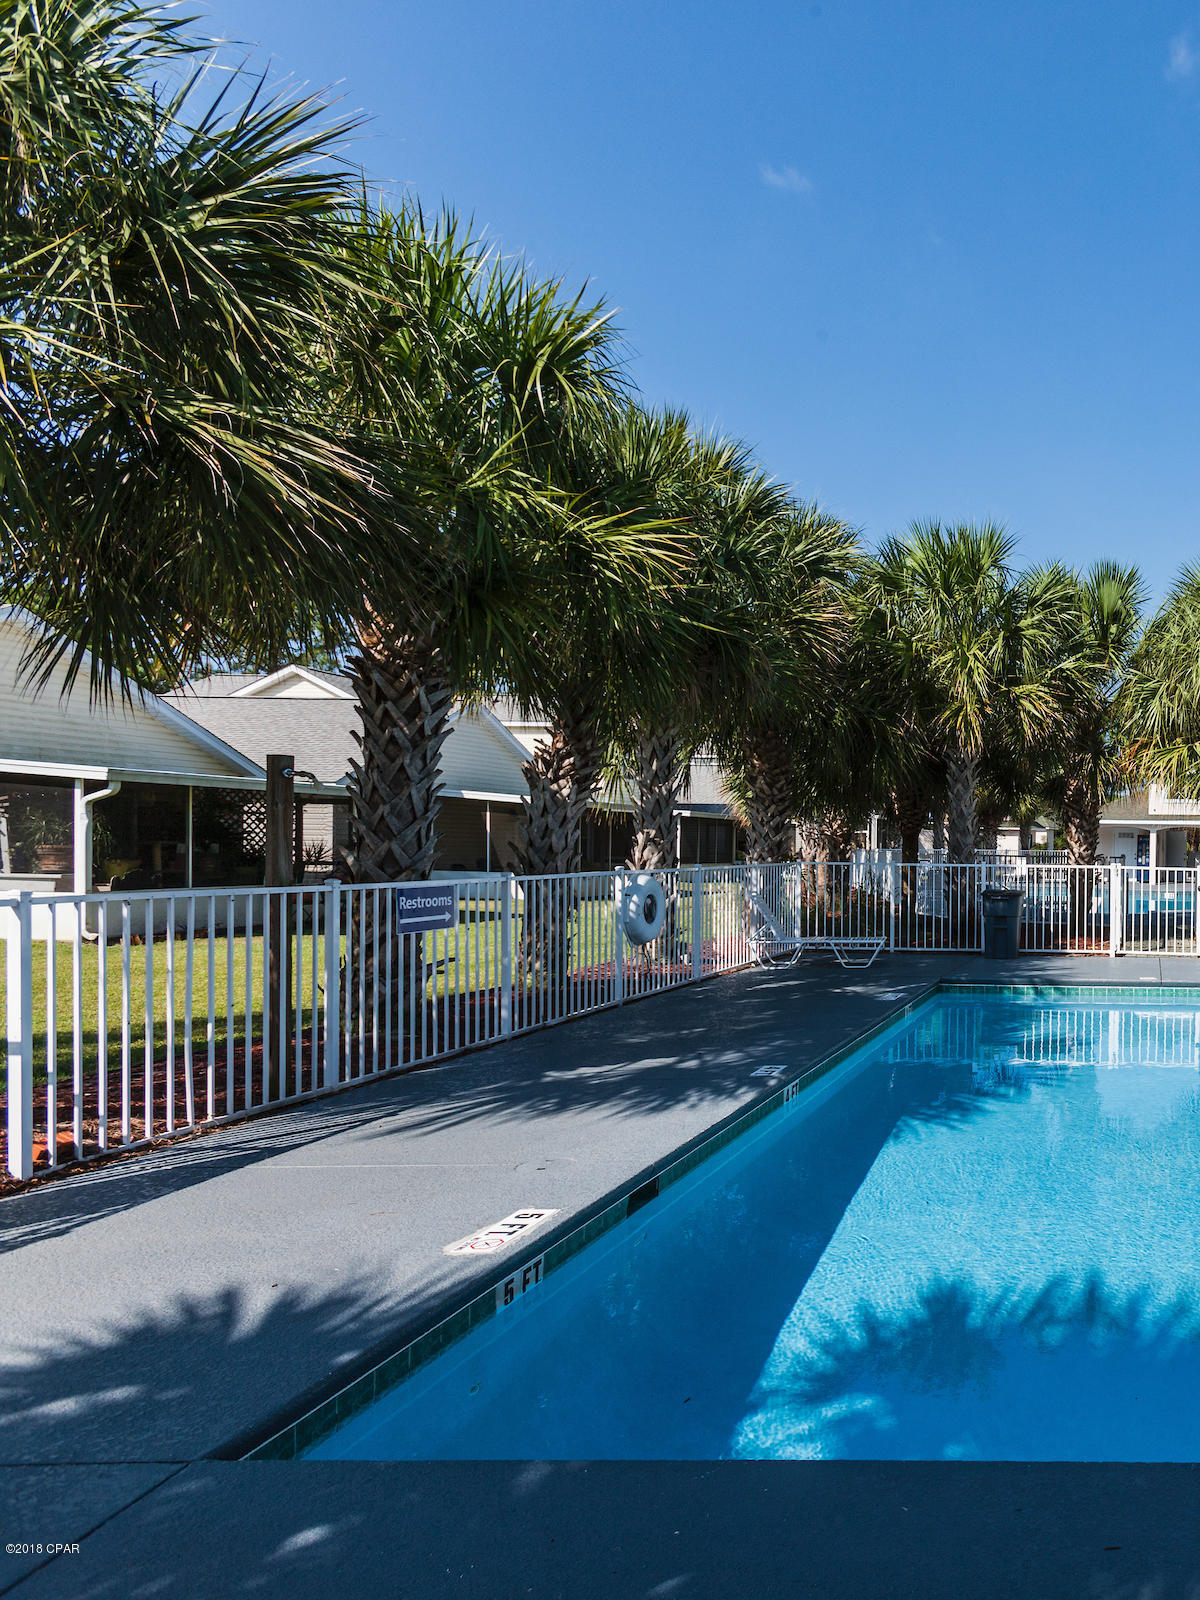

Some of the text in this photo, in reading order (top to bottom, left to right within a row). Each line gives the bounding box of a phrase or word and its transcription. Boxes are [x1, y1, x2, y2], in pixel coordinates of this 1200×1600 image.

[399, 896, 452, 910] Restrooms
[485, 1223, 529, 1236] FT
[504, 1258, 543, 1306] 5 FT
